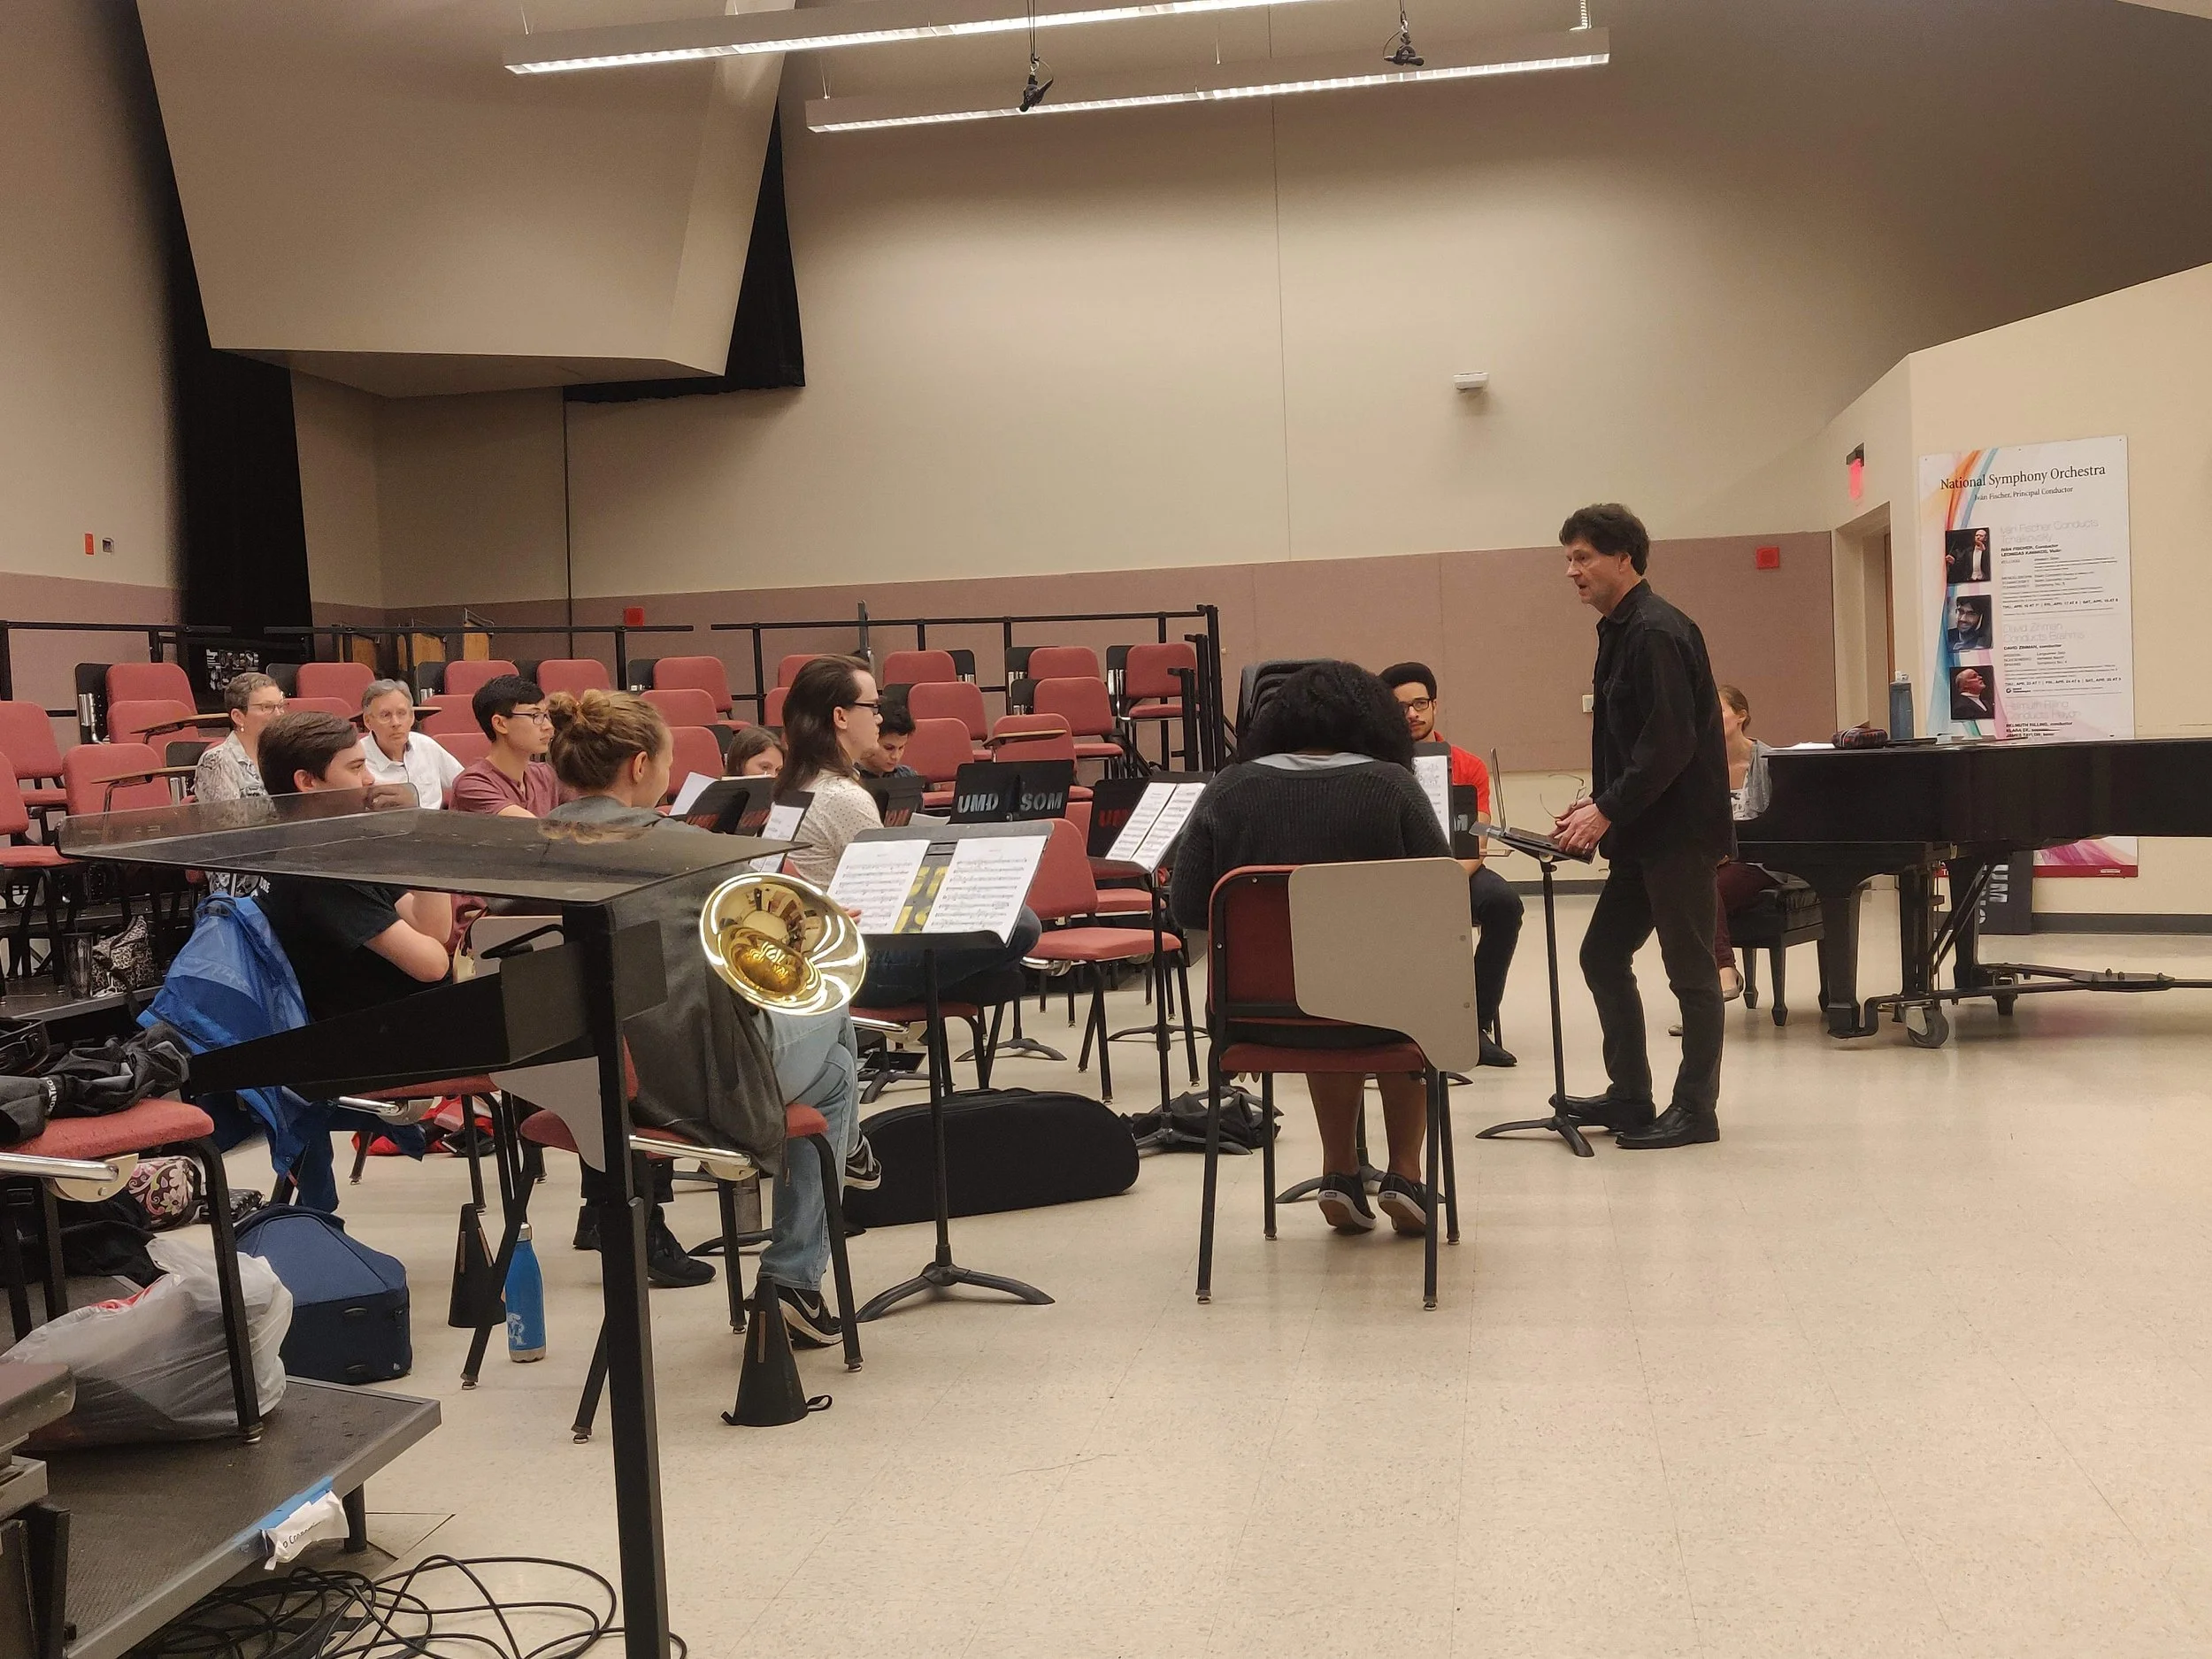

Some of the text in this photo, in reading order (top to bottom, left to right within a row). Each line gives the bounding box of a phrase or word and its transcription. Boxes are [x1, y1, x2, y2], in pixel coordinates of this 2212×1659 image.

[1940, 465, 2106, 490] National Symphony Orchestra
[2013, 488, 2040, 498] Principal
[2041, 486, 2074, 495] Conductor
[957, 791, 1063, 814] UMD SOM
